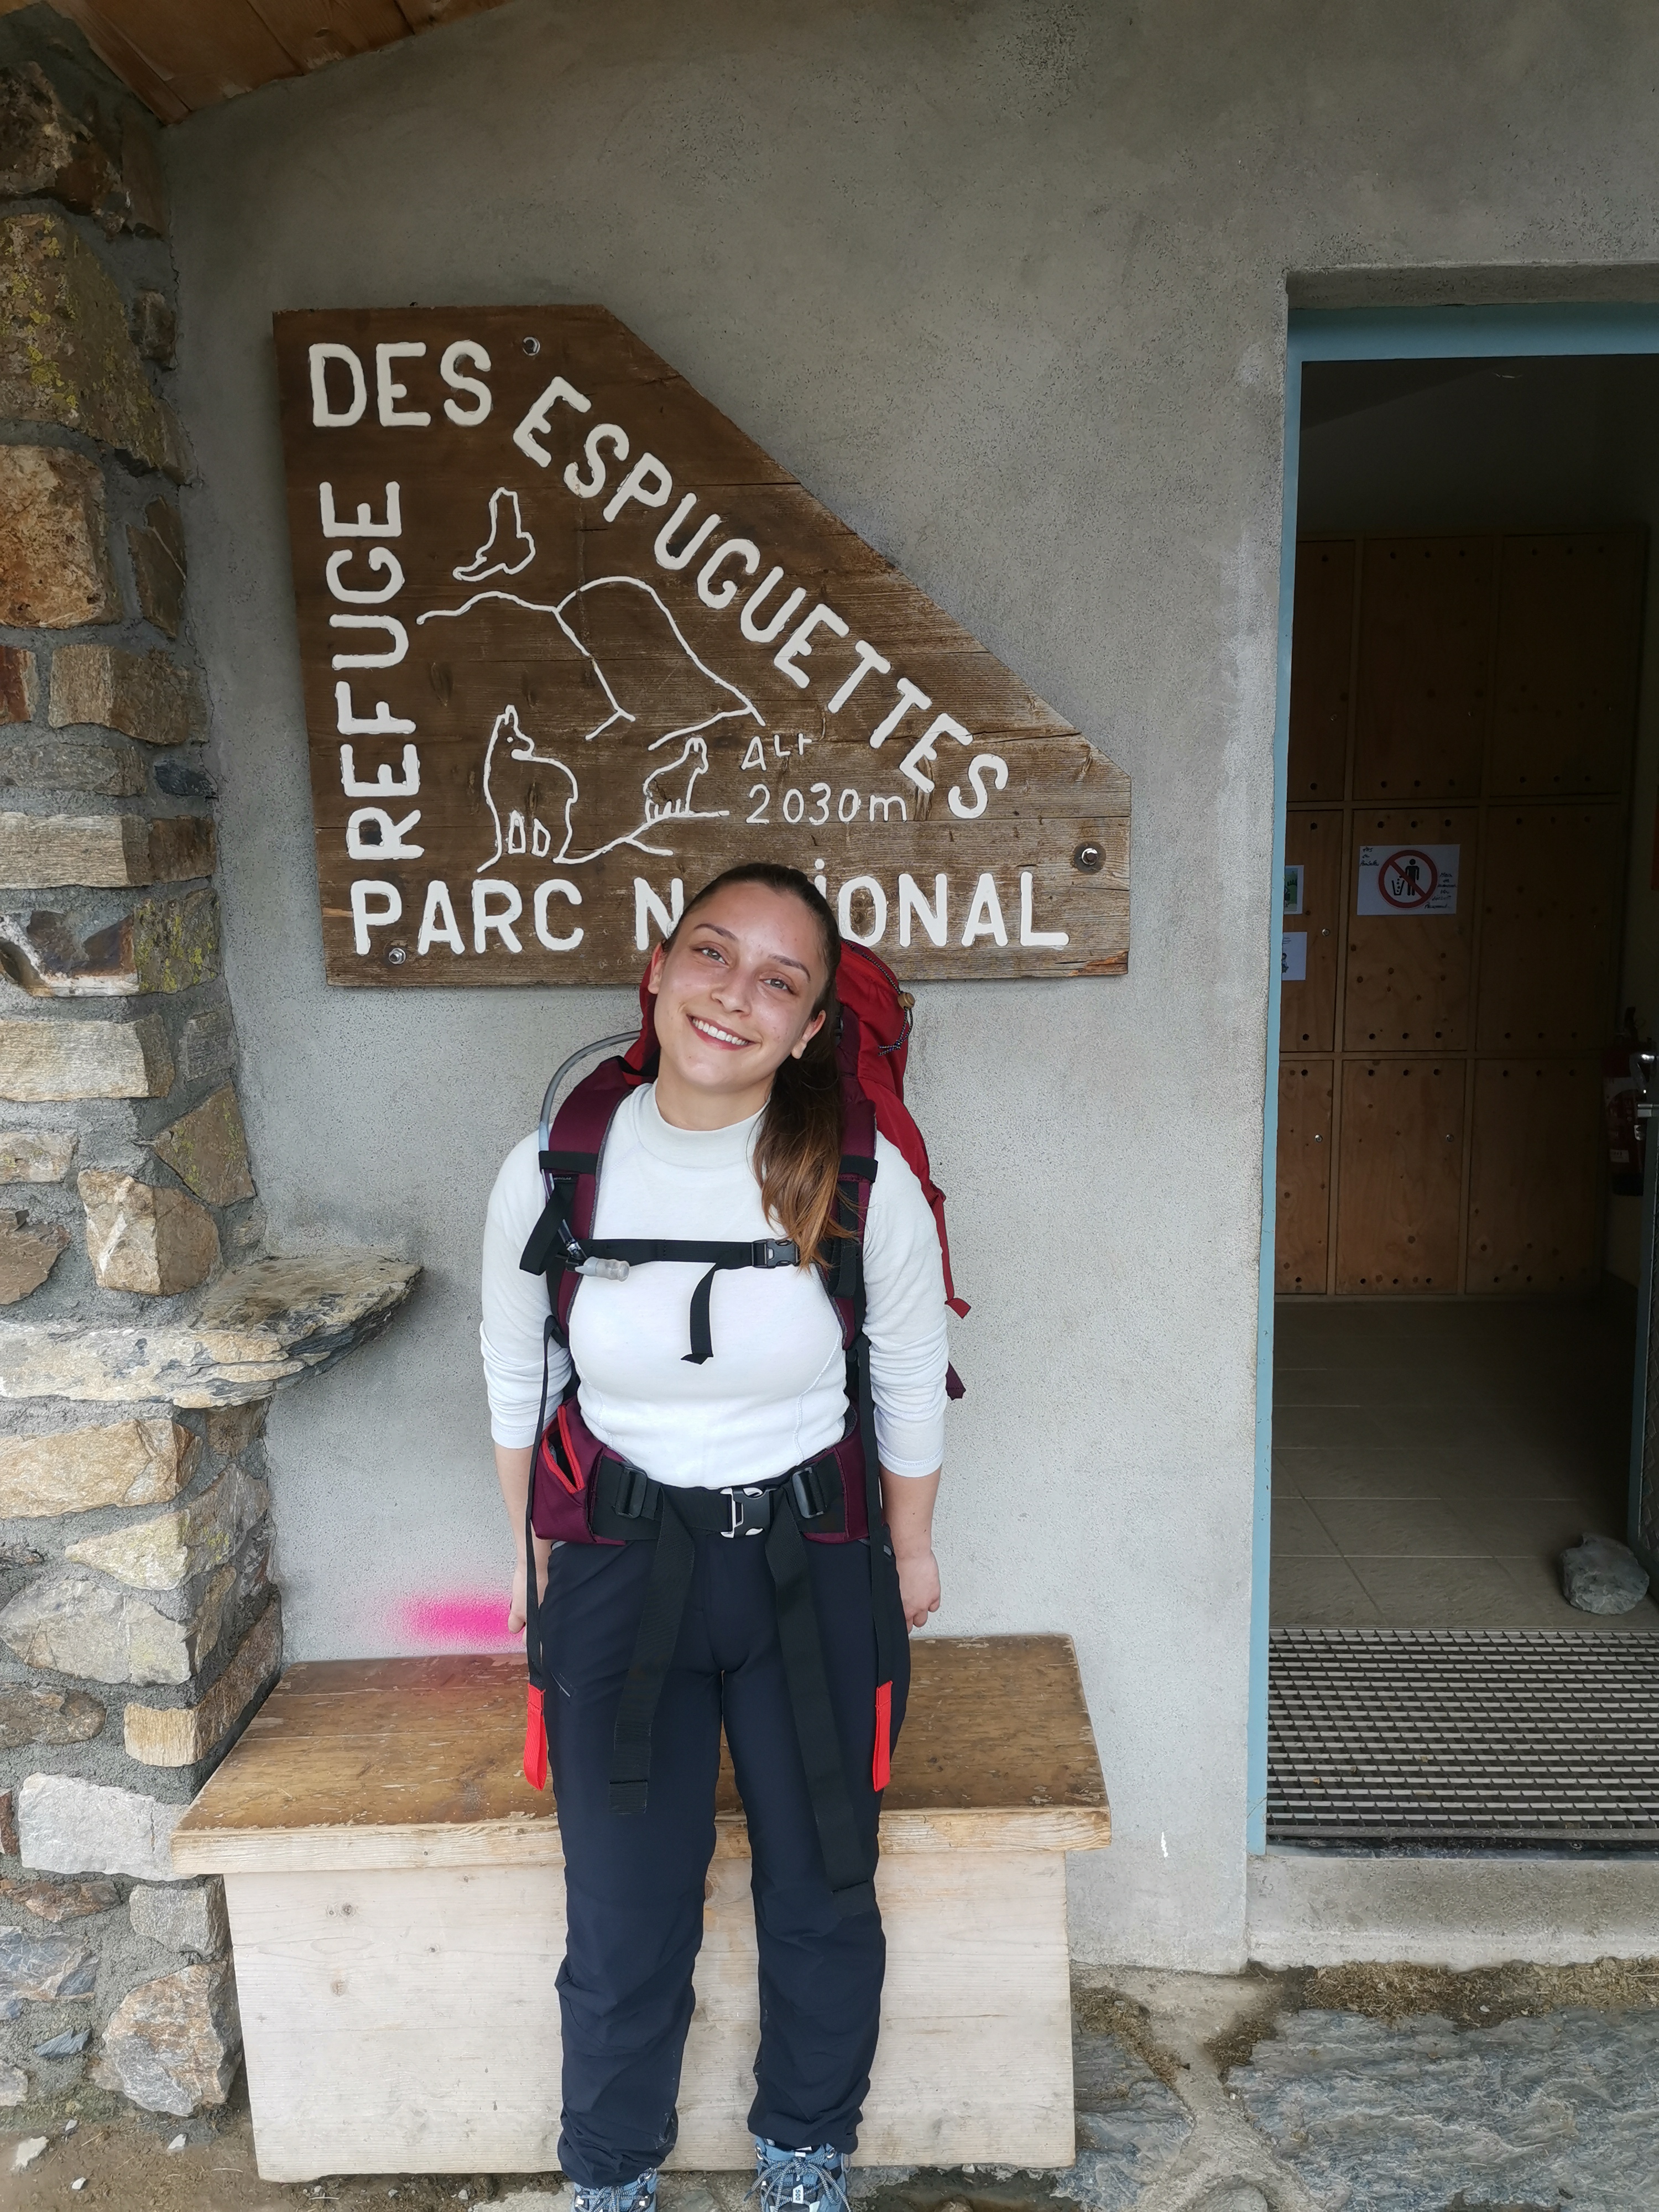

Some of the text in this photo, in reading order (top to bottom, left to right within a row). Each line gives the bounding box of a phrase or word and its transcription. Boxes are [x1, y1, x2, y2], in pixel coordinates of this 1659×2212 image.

[309, 341, 492, 426] DES
[320, 481, 425, 861] REFUGE
[513, 376, 1009, 819] ESPUGUETTES
[350, 858, 1073, 956] PARC NONAL
